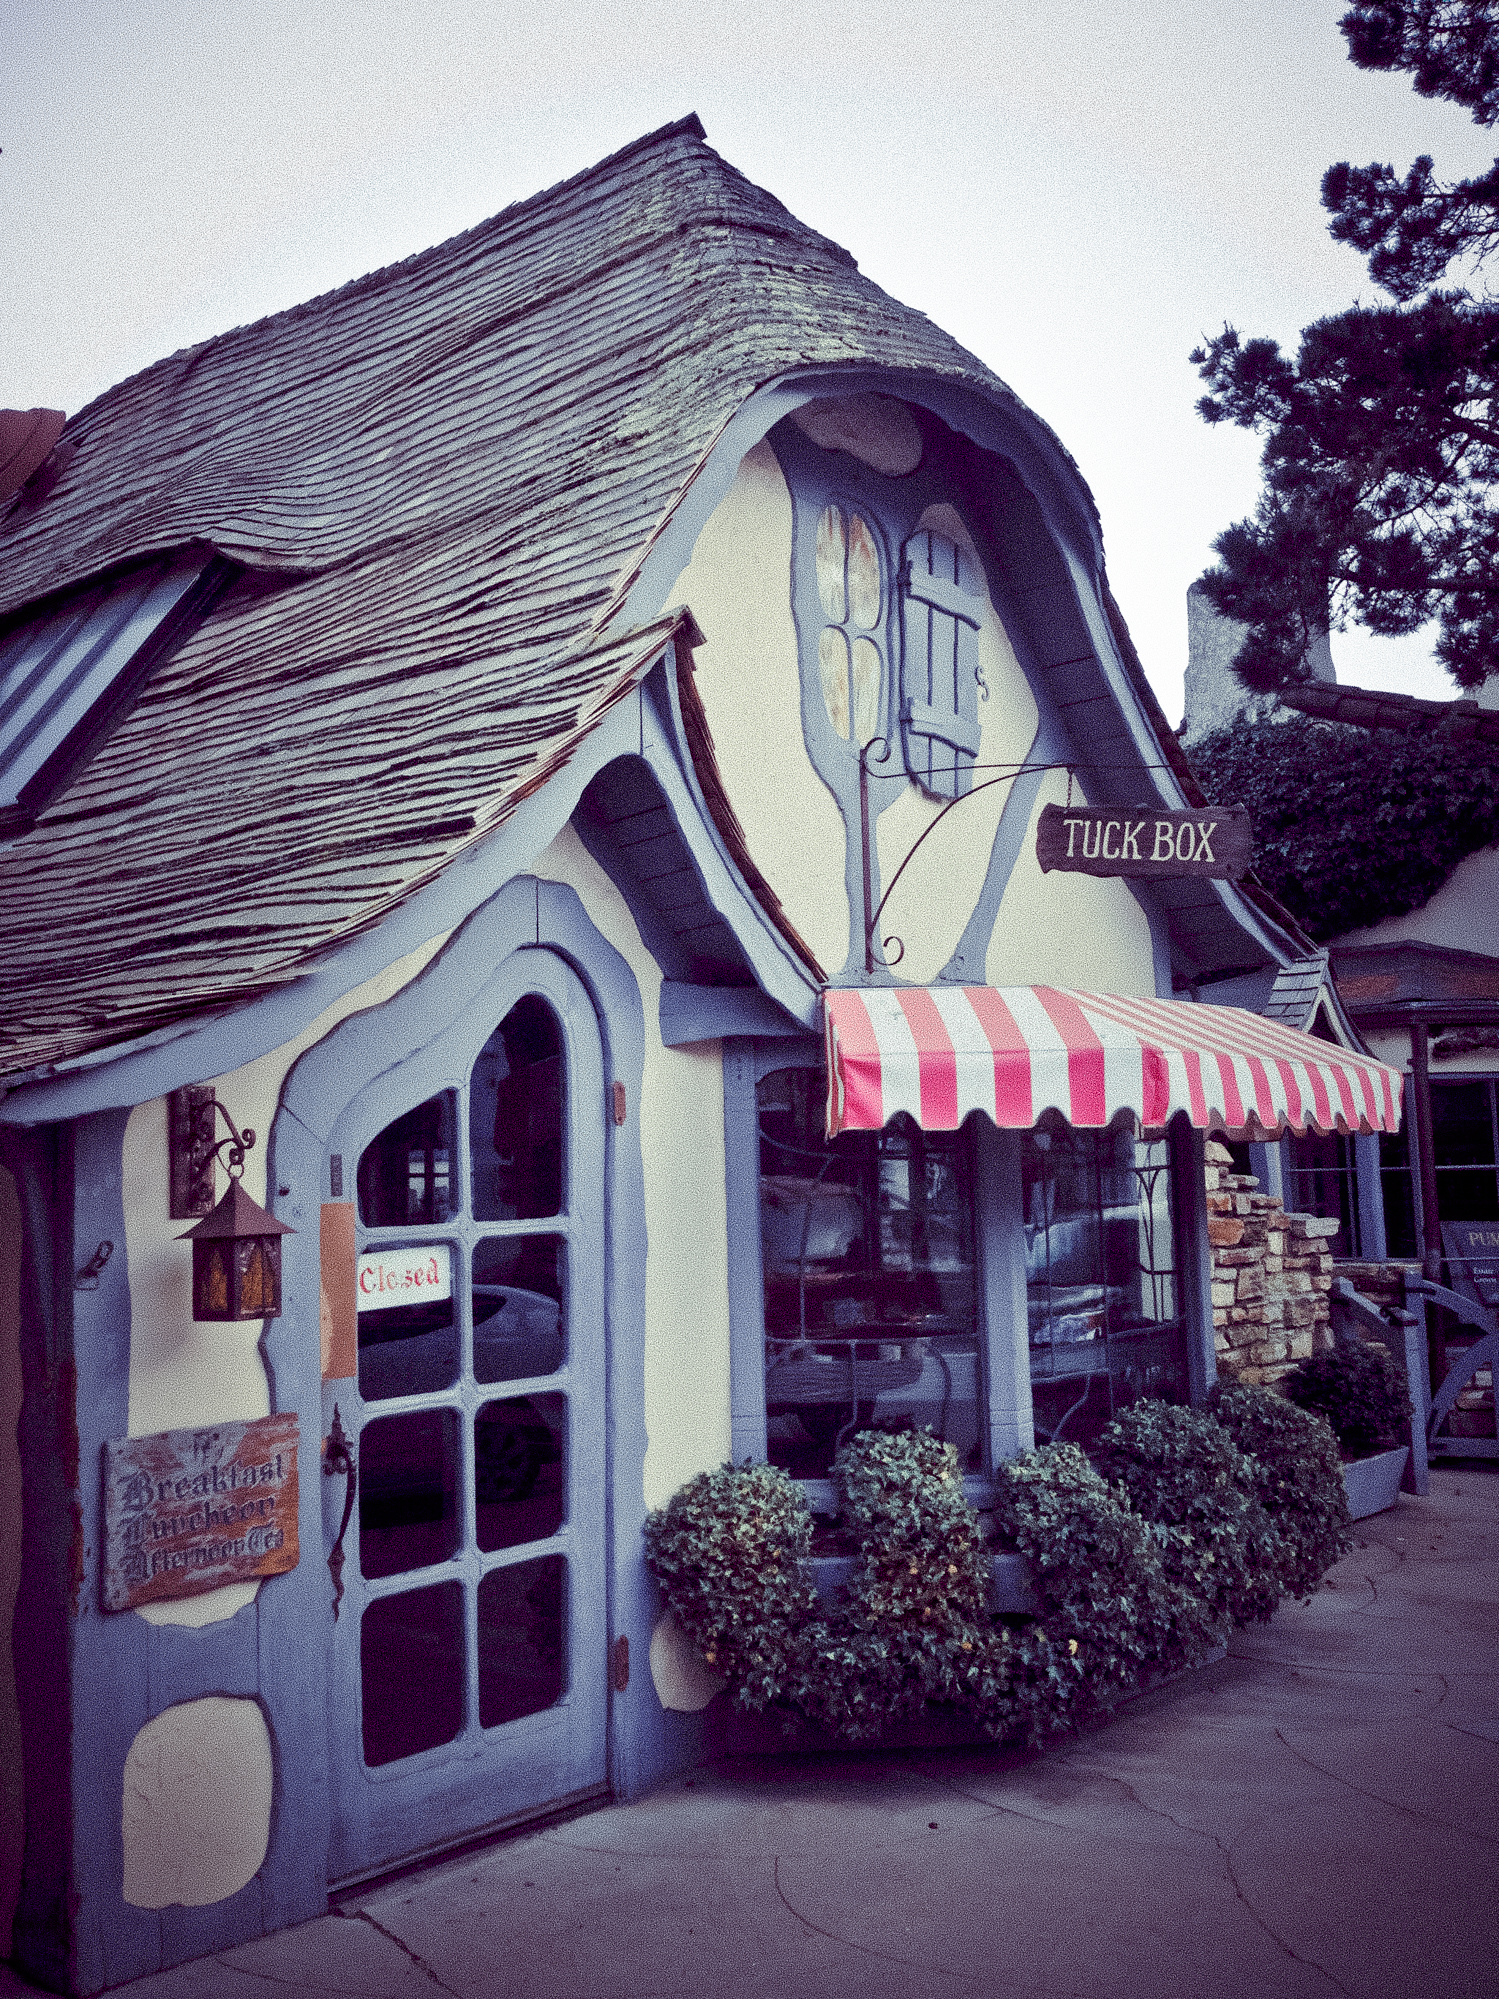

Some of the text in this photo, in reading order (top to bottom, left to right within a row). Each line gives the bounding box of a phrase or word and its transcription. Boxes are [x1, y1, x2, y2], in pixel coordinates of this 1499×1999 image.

[1063, 819, 1218, 863] TUCK BOX
[359, 1257, 440, 1294] Closed
[116, 1453, 283, 1512] Breakfast
[116, 1496, 276, 1550] Luncheon
[117, 1537, 244, 1583] Afternoon
